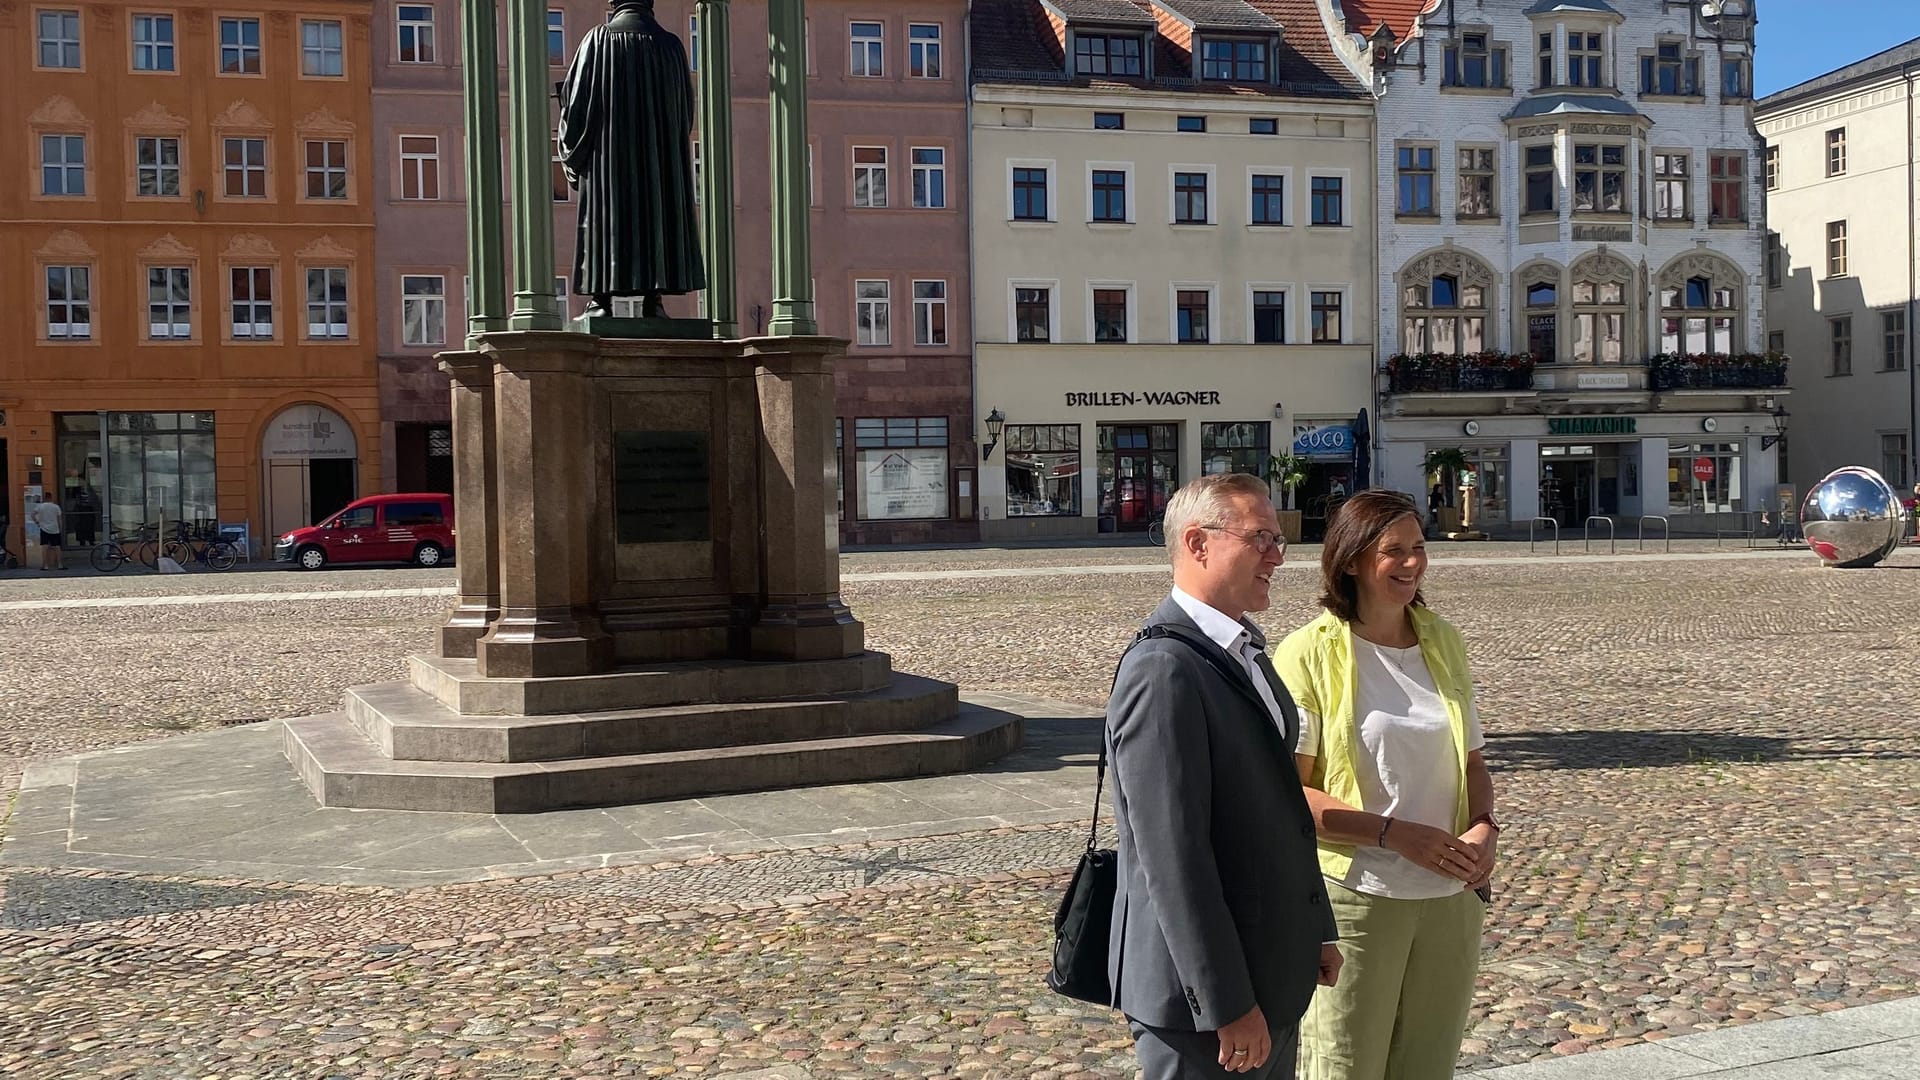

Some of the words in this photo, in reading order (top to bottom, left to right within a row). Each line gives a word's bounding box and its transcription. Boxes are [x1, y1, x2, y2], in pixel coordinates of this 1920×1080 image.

[1530, 317, 1555, 325] CLACK
[1065, 391, 1221, 407] BRILLEN-WAGNER
[1548, 416, 1637, 434] SALAMANDER
[1298, 431, 1344, 447] COCO
[1694, 465, 1714, 474] SALE
